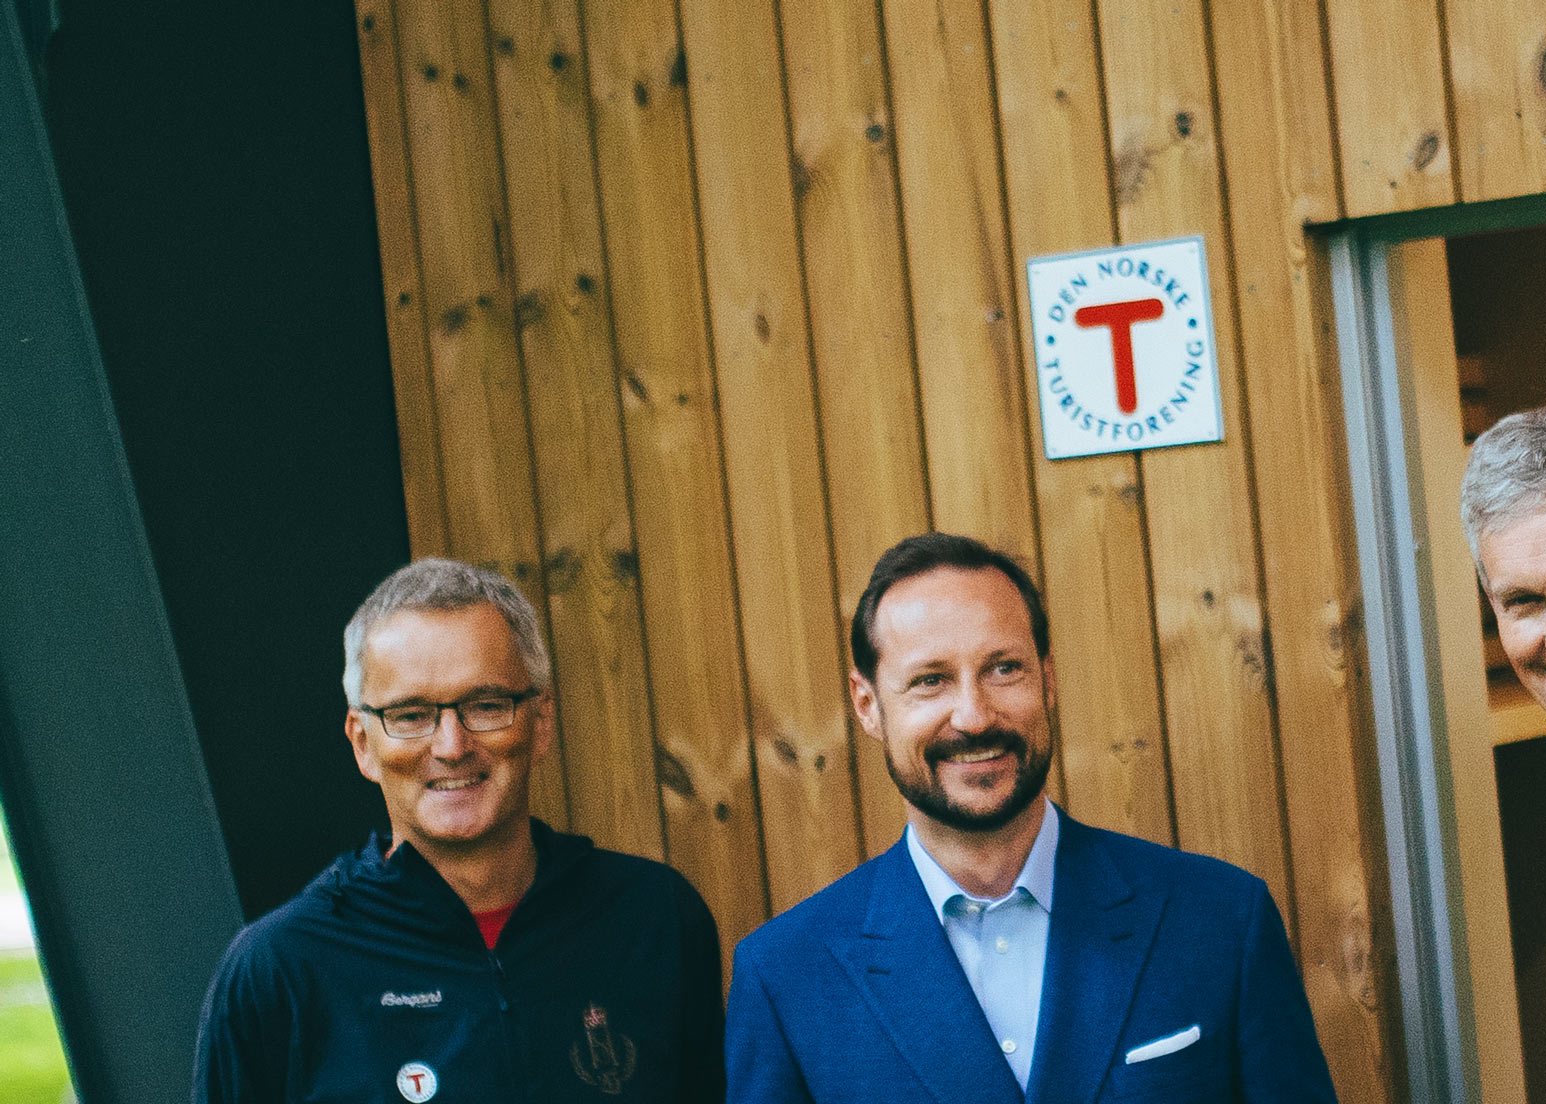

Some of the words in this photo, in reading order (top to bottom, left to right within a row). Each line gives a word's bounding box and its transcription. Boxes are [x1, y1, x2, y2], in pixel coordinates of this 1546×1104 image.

[1048, 272, 1089, 324] DEN
[1097, 257, 1190, 311] NORSKE
[1044, 338, 1205, 442] TURISTFORENING
[1075, 298, 1163, 416] T
[406, 1073, 425, 1095] T
